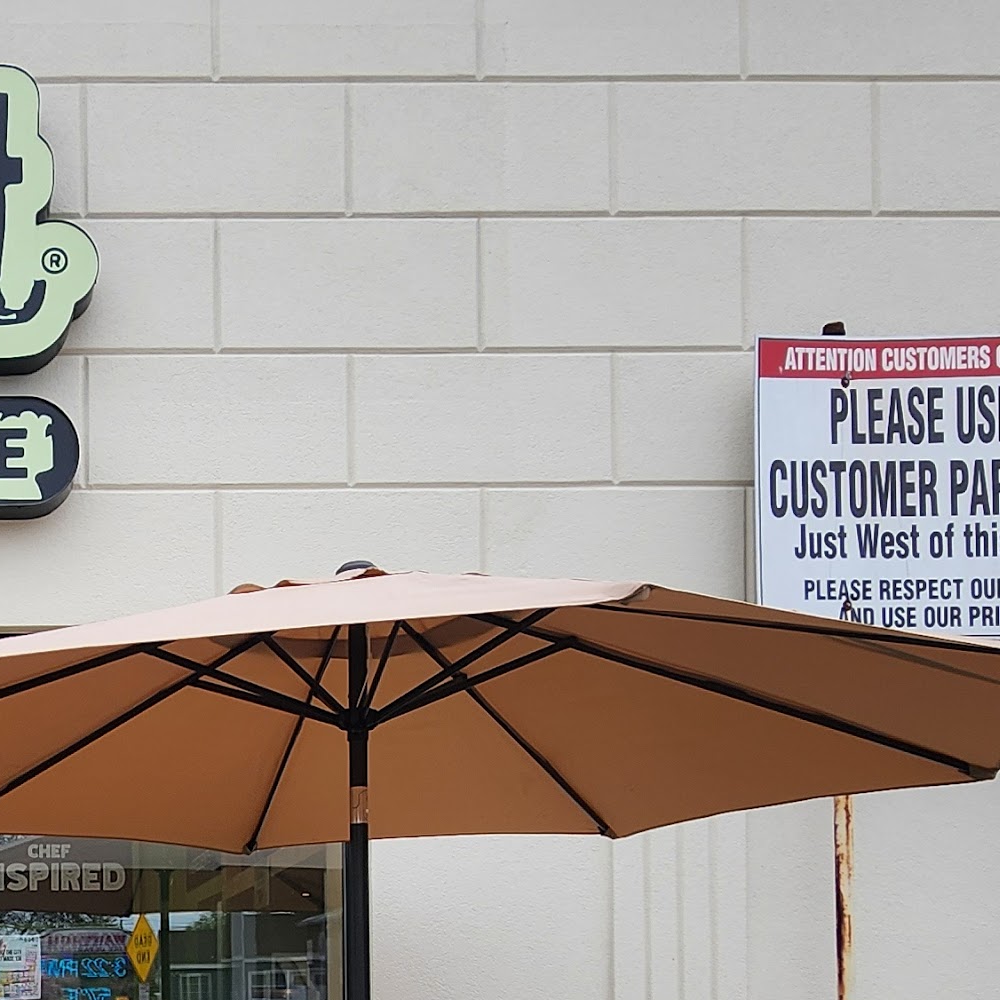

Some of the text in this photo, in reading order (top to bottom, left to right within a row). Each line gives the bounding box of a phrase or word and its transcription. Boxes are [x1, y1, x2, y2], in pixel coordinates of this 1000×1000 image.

[784, 346, 877, 372] ATTENTION
[881, 345, 990, 371] CUSTOMERS
[830, 385, 1000, 445] PLEASE US
[769, 459, 938, 519] CUSTOMER
[794, 521, 1000, 559] Just West of thi
[804, 578, 1000, 601] PLEASE RESPECT OU
[882, 607, 916, 628] USE
[924, 606, 962, 627] OUR
[27, 843, 71, 859] CHEF
